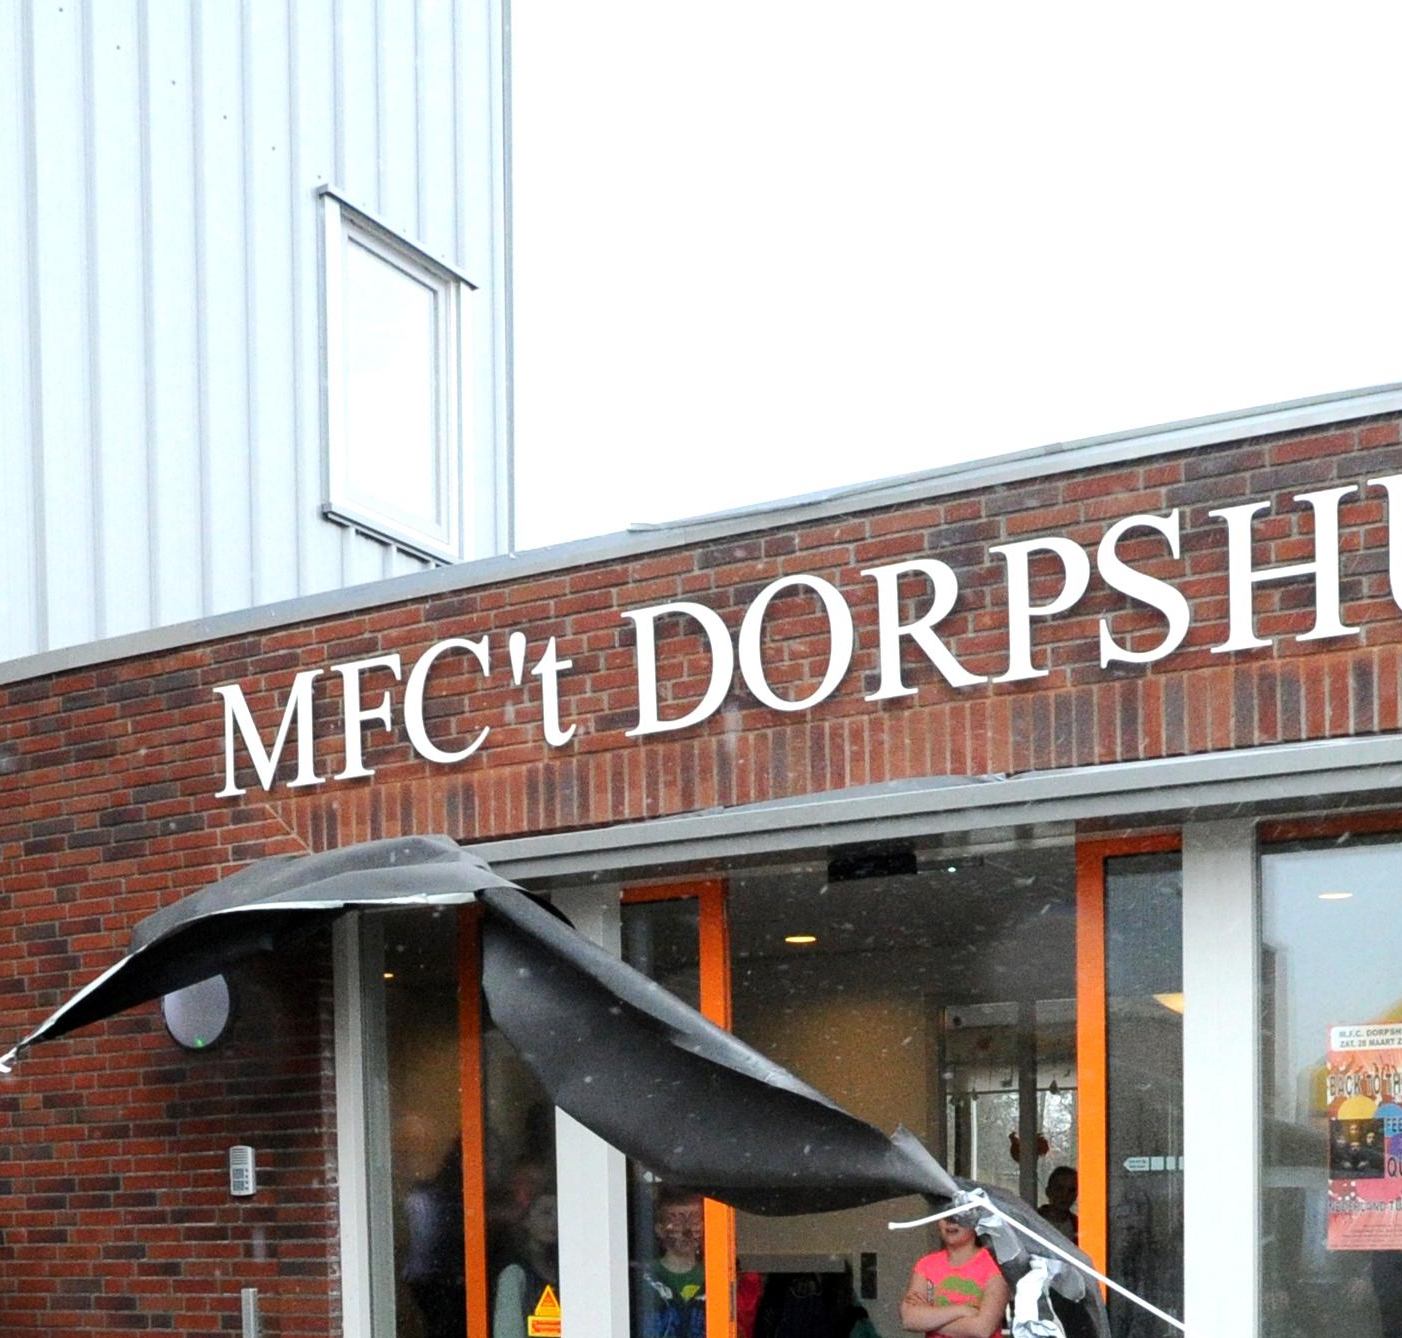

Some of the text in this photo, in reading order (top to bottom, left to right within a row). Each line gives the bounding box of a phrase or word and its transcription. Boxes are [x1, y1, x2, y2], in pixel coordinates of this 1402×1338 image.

[213, 630, 577, 800] MFC't
[1369, 1038, 1395, 1047] MAART
[1329, 1073, 1361, 1096] BACK
[1366, 1072, 1380, 1095] TO
